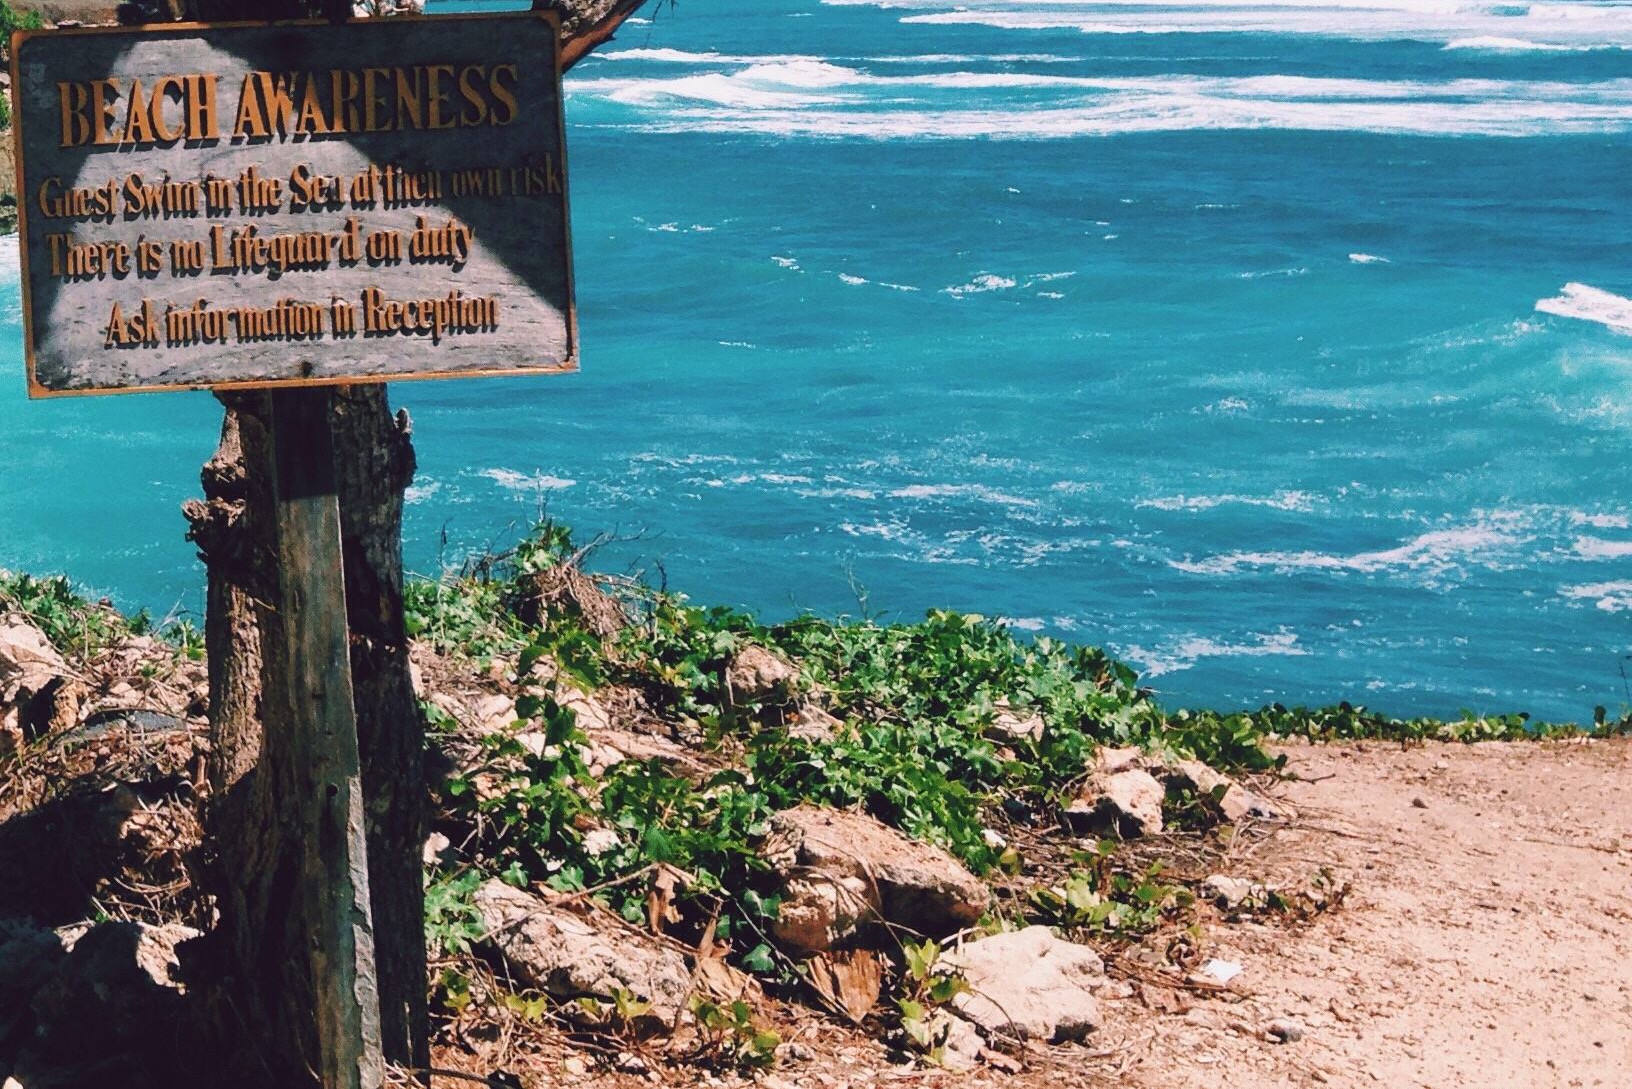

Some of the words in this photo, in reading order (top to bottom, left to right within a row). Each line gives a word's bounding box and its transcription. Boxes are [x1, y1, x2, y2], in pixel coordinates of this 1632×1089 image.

[58, 72, 218, 148] BEACH
[233, 64, 518, 137] AWARENESS
[39, 174, 119, 218] Guest
[125, 171, 199, 215] Swim
[206, 169, 234, 209] in
[240, 163, 283, 208] the
[451, 168, 503, 198] own
[510, 150, 562, 196] risk
[46, 232, 131, 277] There
[138, 231, 164, 273] is
[171, 237, 206, 270] no
[368, 229, 404, 261] on
[412, 215, 476, 263] duty
[105, 296, 161, 346] Ask
[167, 295, 324, 342] information
[332, 295, 356, 336] in
[363, 286, 500, 339] Reception
